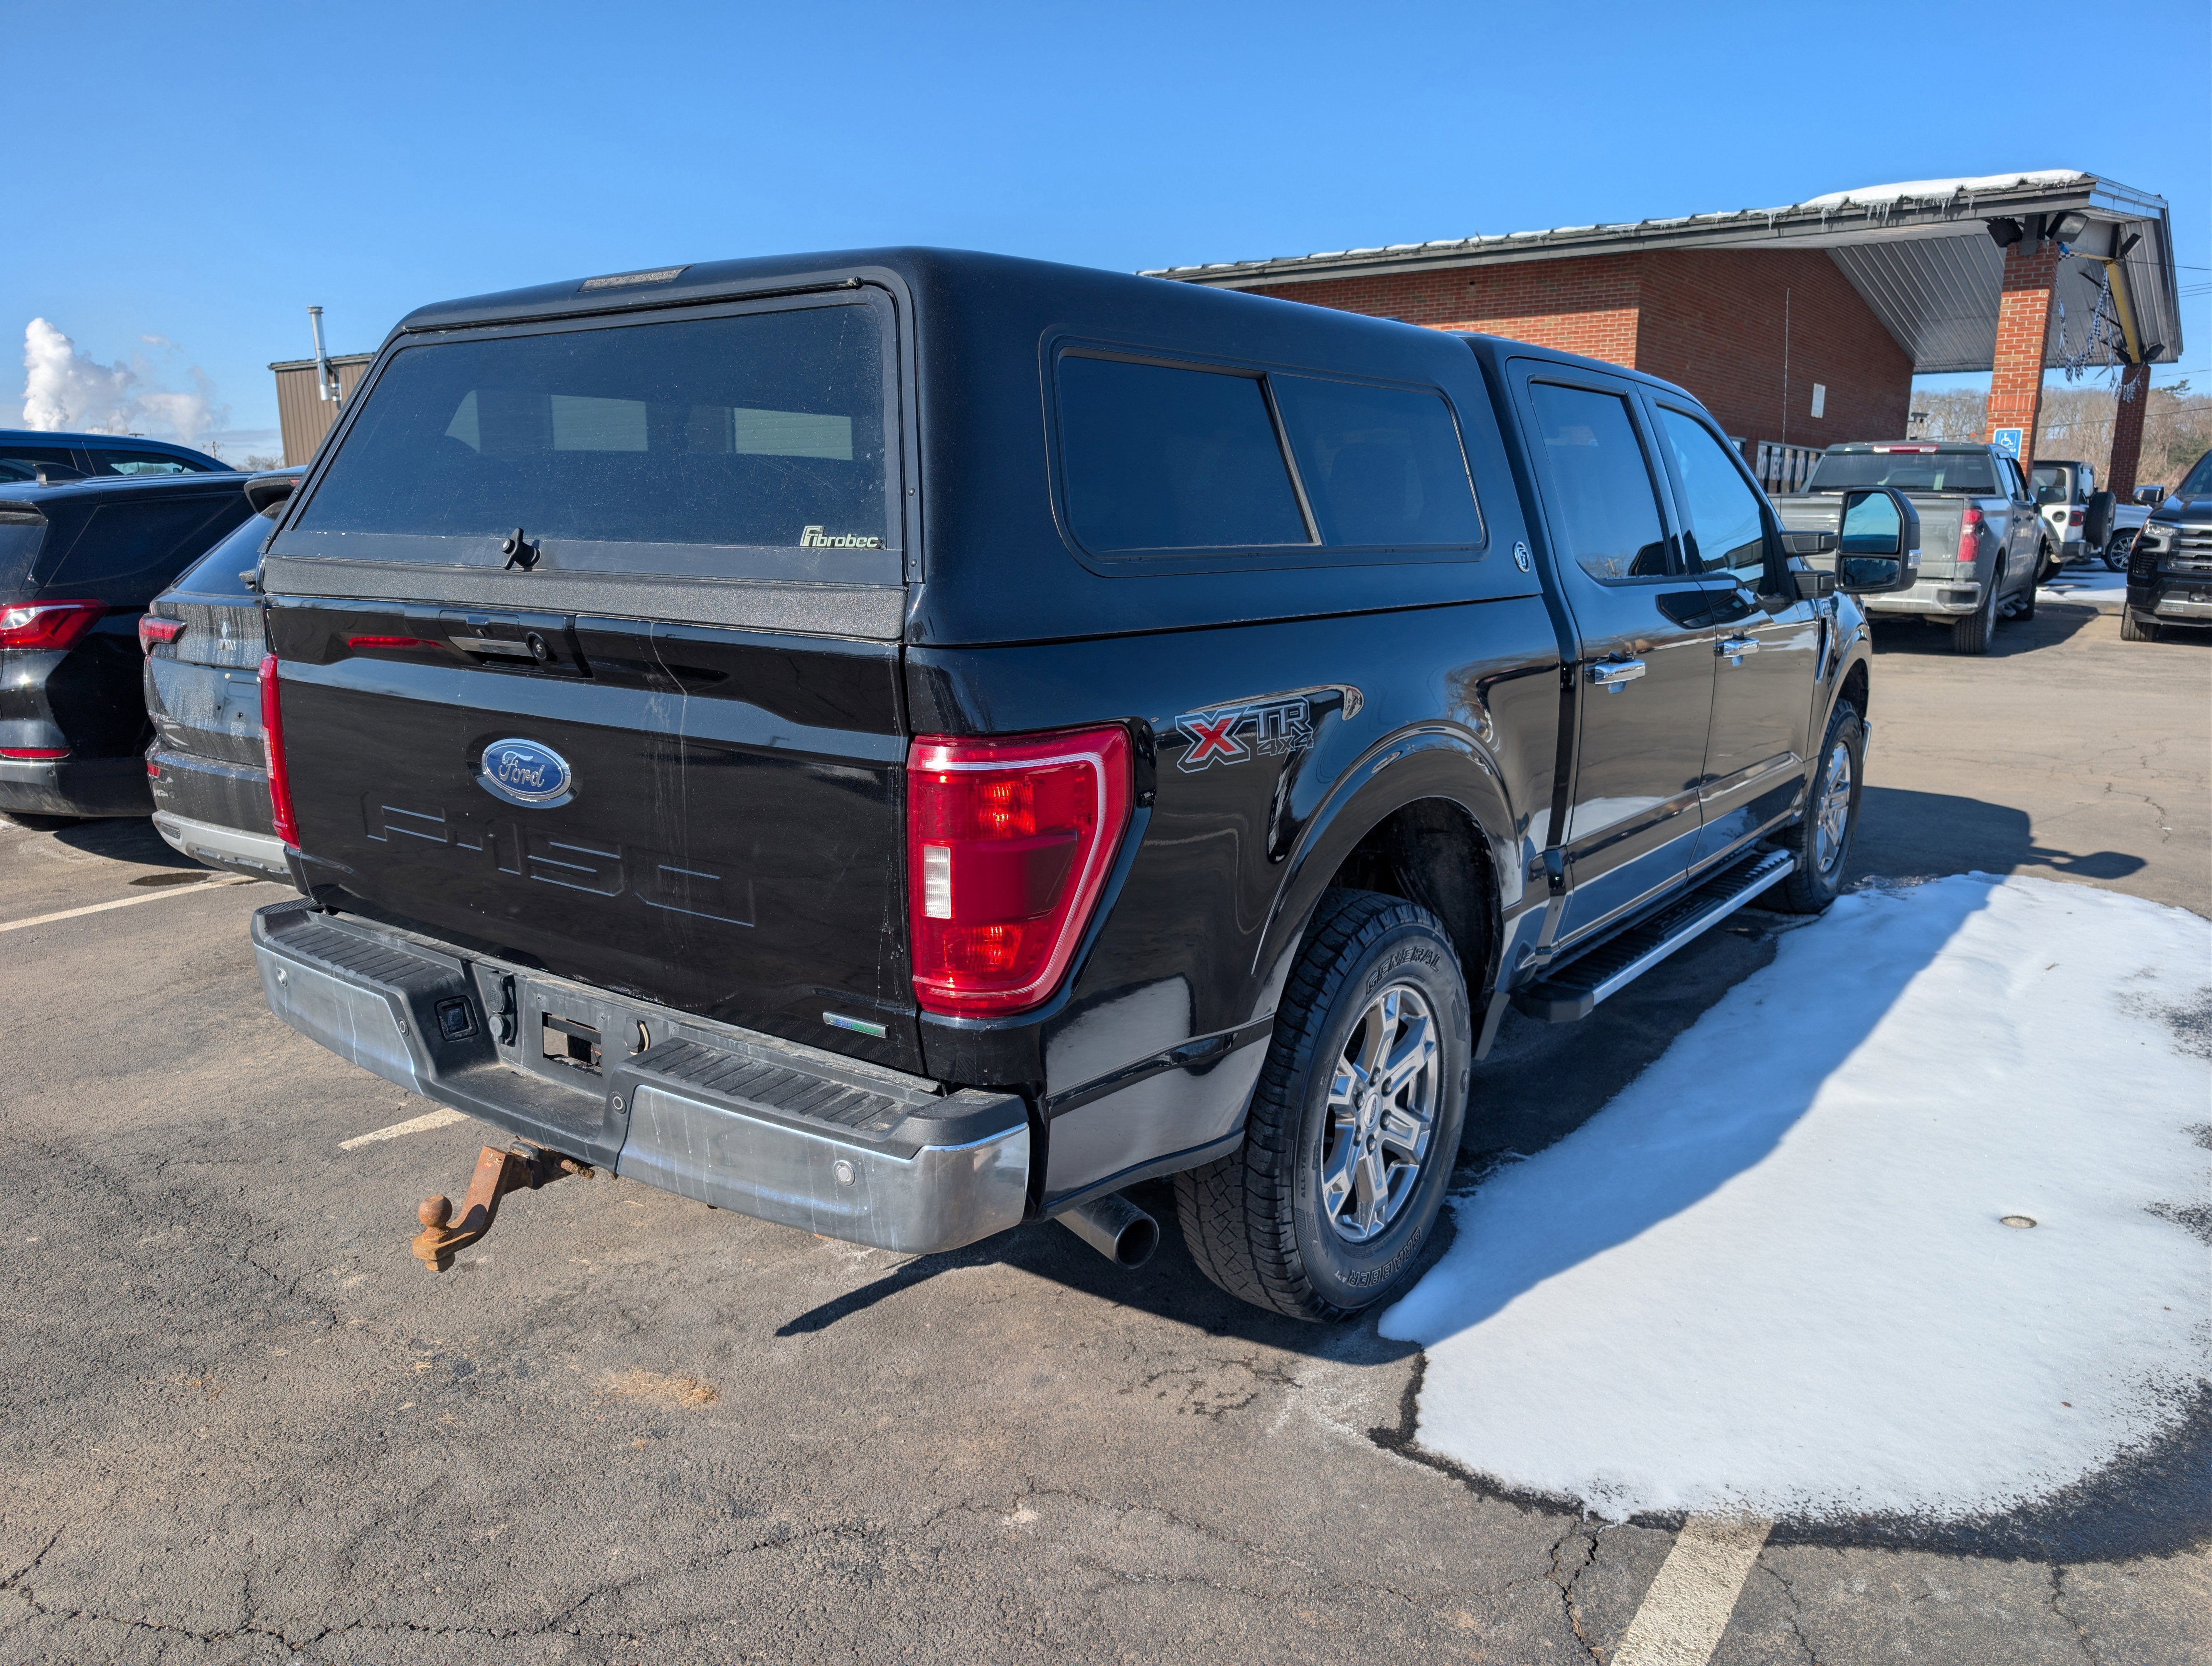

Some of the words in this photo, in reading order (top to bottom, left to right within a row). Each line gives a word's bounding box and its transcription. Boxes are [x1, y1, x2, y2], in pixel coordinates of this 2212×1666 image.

[800, 525, 878, 547] Fibrobec
[1174, 696, 1313, 773] XTR
[498, 750, 545, 787] Ford
[1366, 946, 1440, 997] GENERAL
[1347, 1226, 1422, 1288] GRABBER
